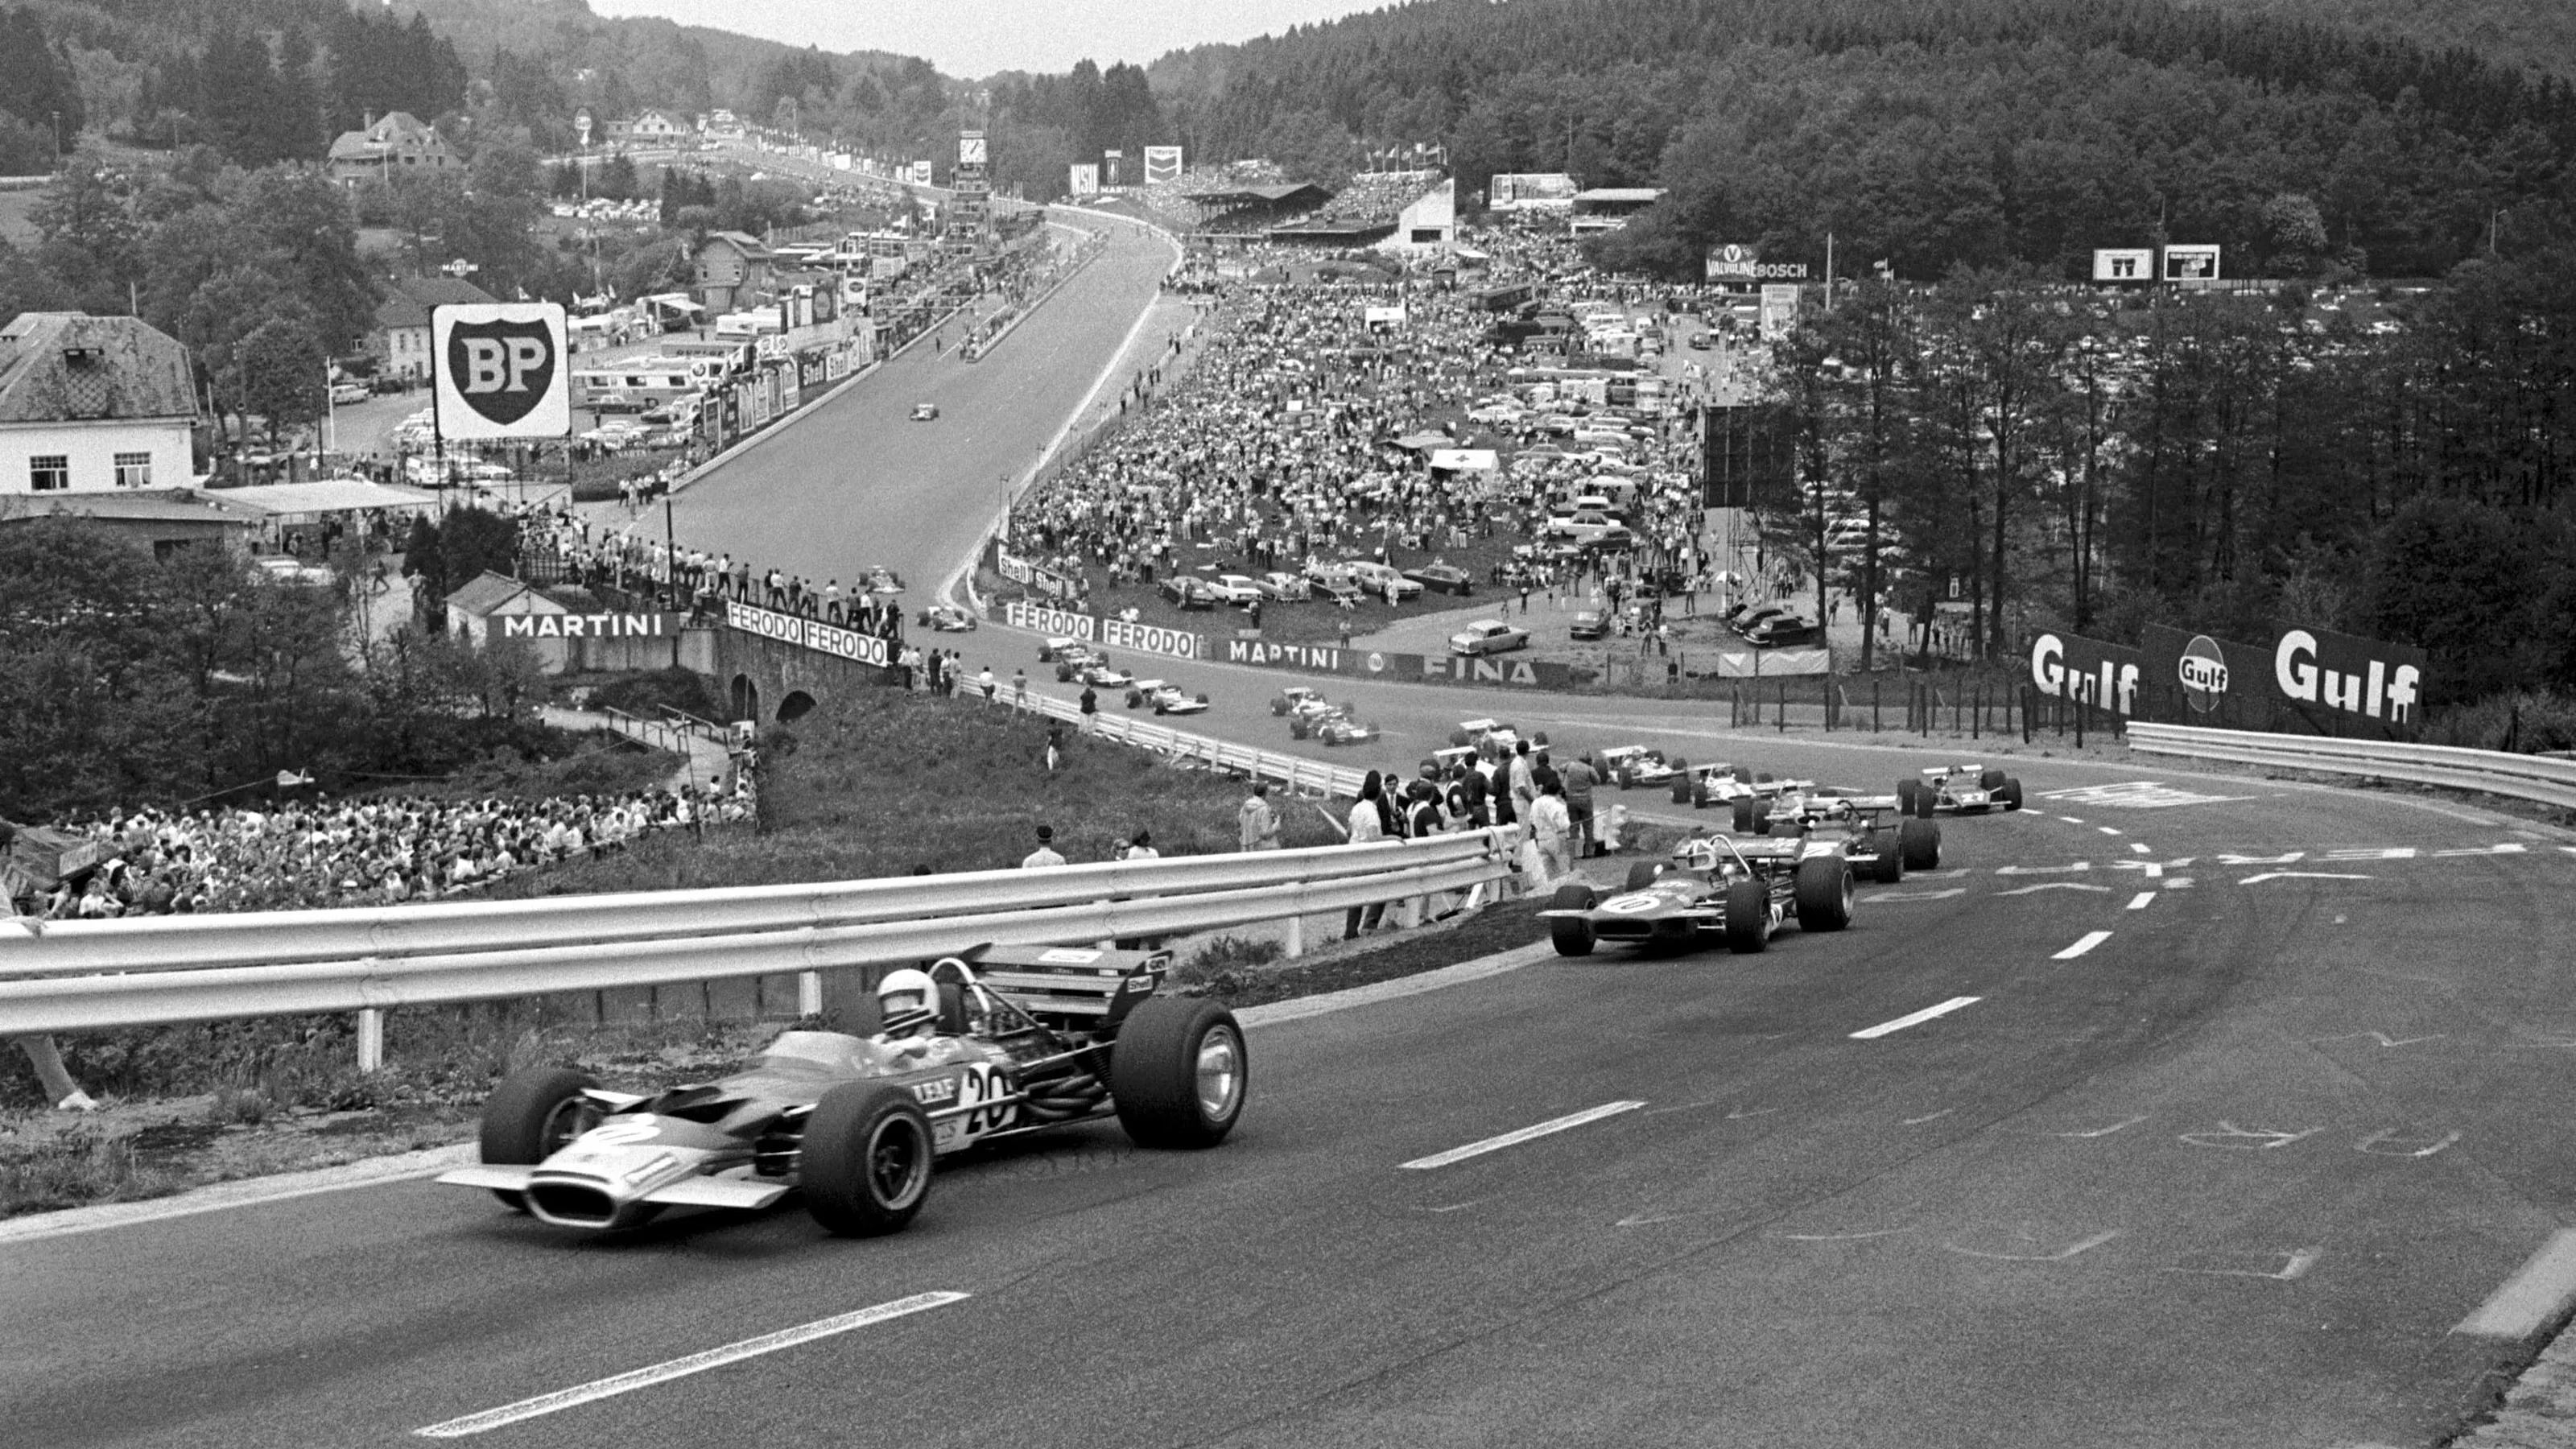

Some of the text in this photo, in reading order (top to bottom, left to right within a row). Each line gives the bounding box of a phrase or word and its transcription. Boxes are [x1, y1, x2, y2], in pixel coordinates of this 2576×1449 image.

[1071, 164, 1098, 194] NSU
[442, 264, 479, 272] MARTINI
[1706, 258, 1757, 278] VALVOLINE
[1757, 263, 1807, 278] BOSCH
[461, 336, 547, 394] BP
[803, 360, 824, 386] Shell
[1001, 557, 1028, 582] Shell
[1035, 571, 1063, 596] Shell
[504, 613, 662, 638] MARTINI
[729, 604, 800, 642] FERODO
[1011, 605, 1091, 638] FERODO
[807, 623, 886, 665] FERODO
[1106, 621, 1191, 656] FERODO
[1230, 640, 1338, 670] MARTINI
[1423, 655, 1538, 684] FINA
[2032, 634, 2140, 715] Gulf
[2181, 658, 2227, 689] Gulf
[2275, 630, 2420, 724] Gulf
[1610, 896, 1652, 910] 10
[965, 1065, 1009, 1135] 20
